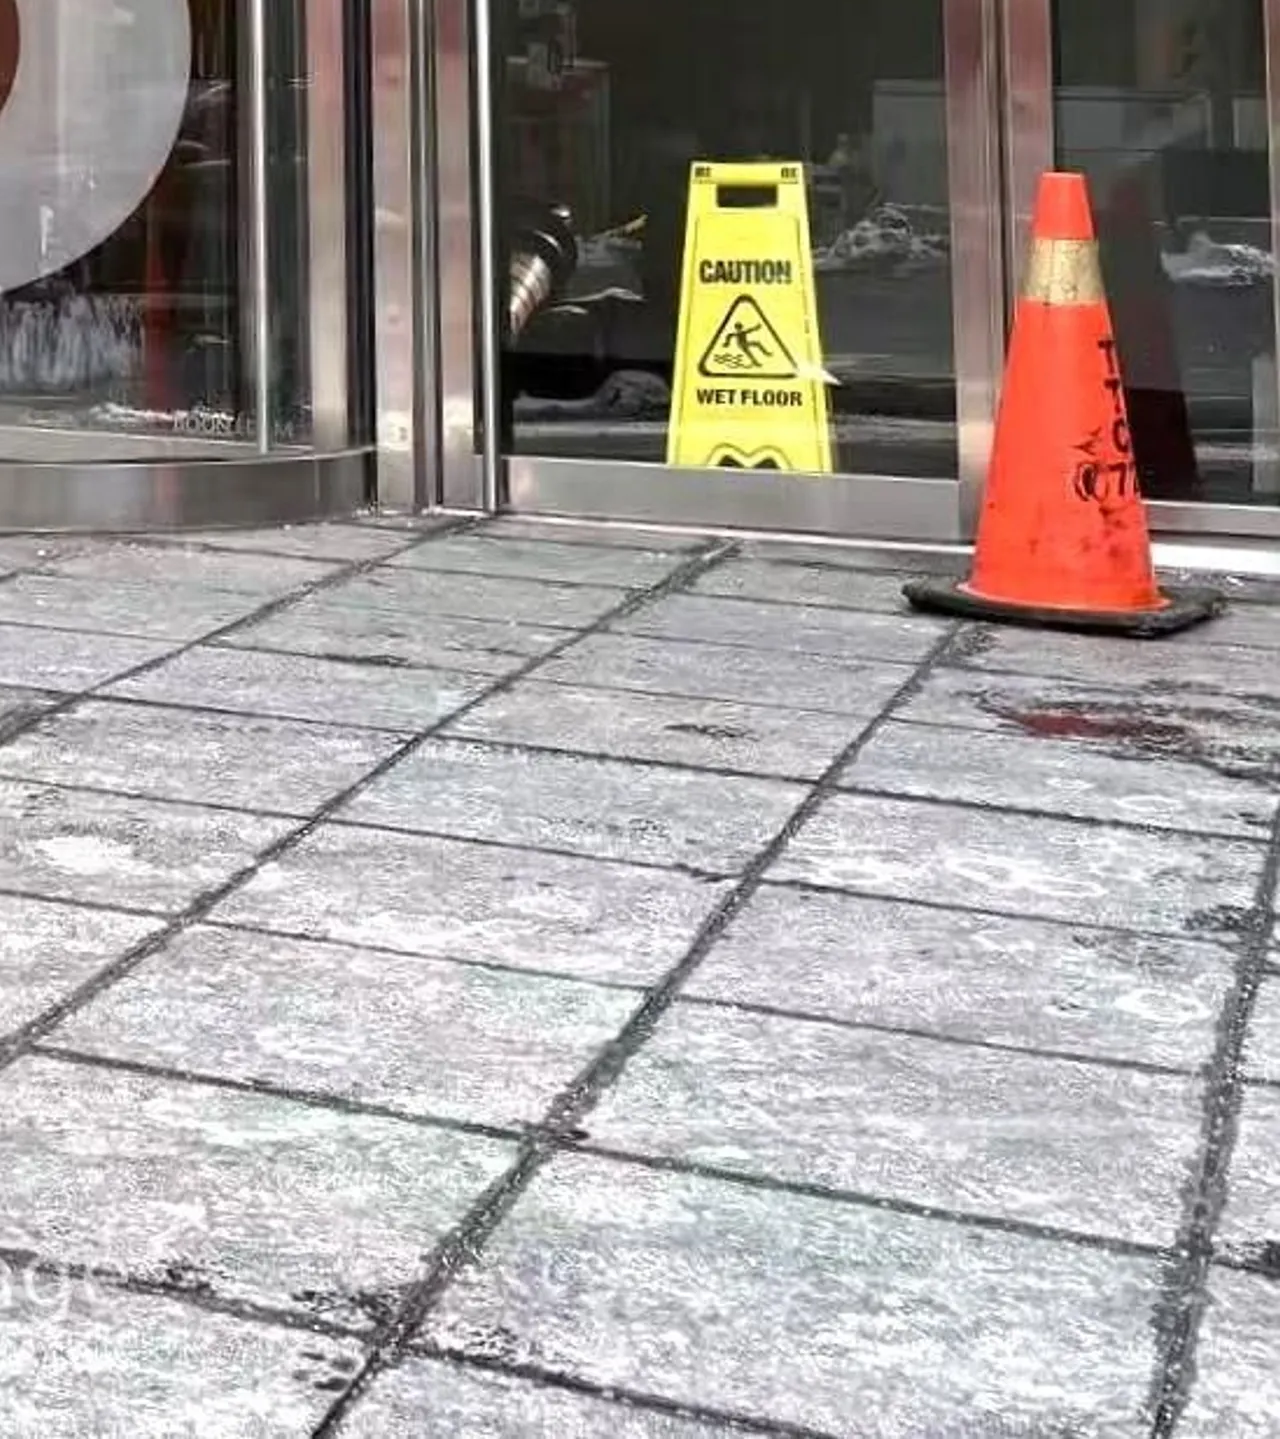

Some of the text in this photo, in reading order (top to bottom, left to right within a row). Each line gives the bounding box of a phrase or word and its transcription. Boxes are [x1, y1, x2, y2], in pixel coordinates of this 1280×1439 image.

[699, 258, 793, 285] CAUTION
[696, 388, 804, 407] WET FLOOR
